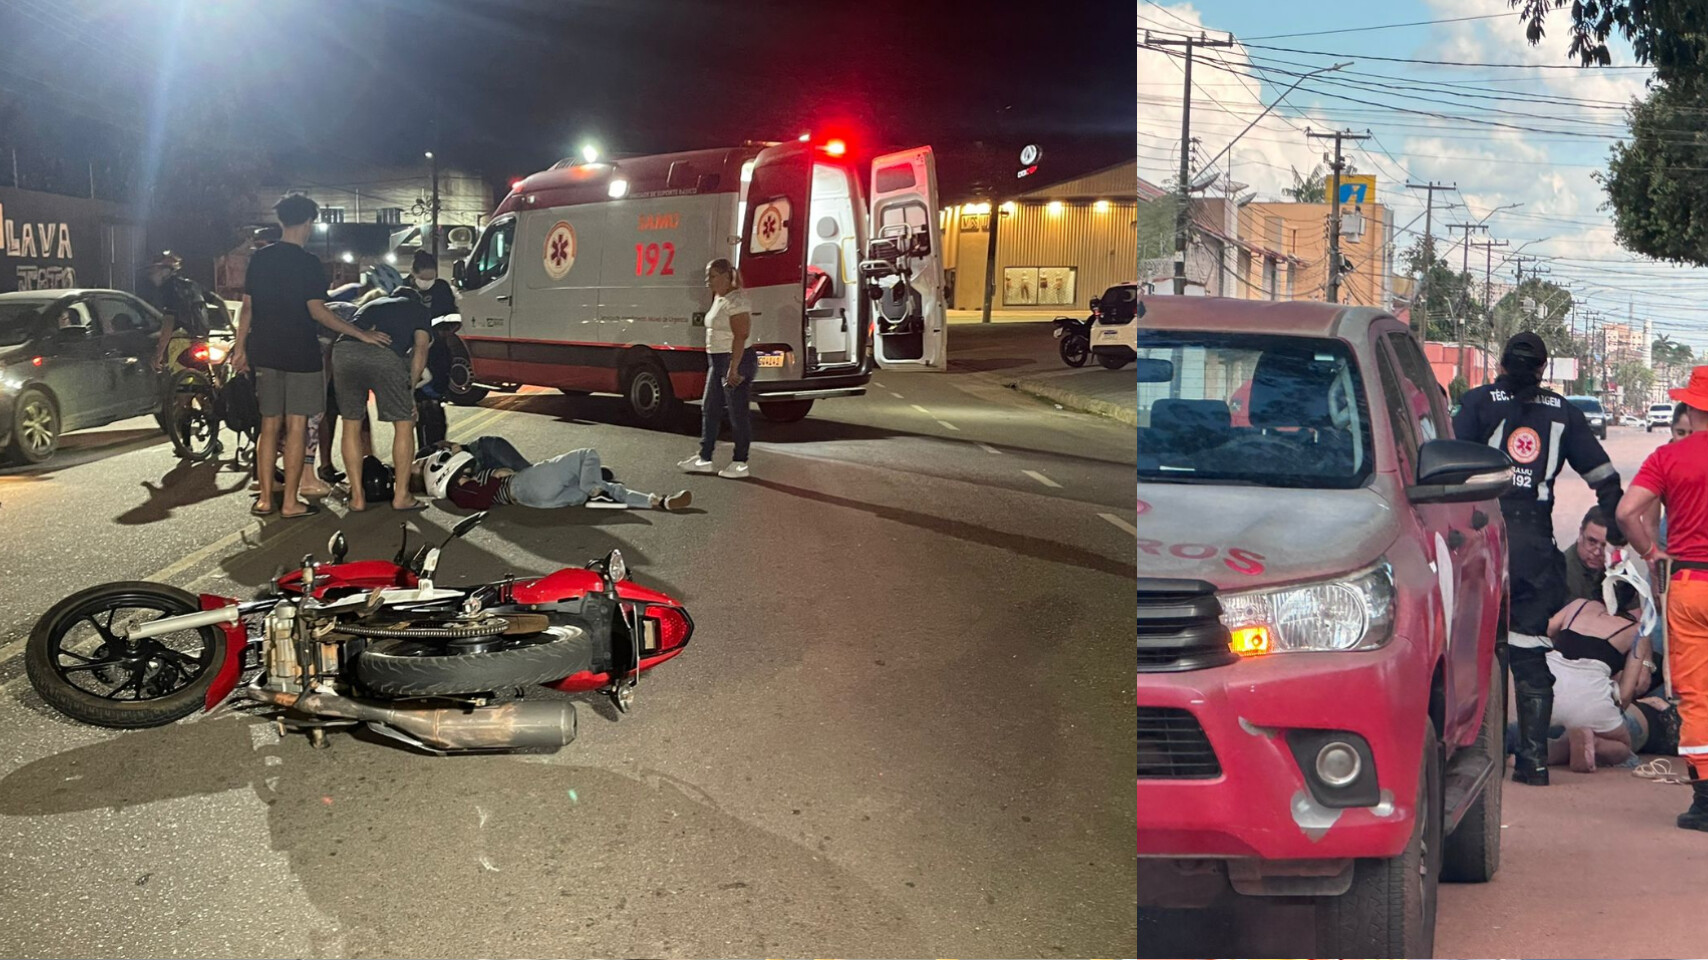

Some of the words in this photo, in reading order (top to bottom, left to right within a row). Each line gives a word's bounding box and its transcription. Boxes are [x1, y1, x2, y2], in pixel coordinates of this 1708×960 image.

[4, 218, 74, 259] LAVA
[634, 241, 677, 277] 192
[1512, 475, 1532, 488] 192
